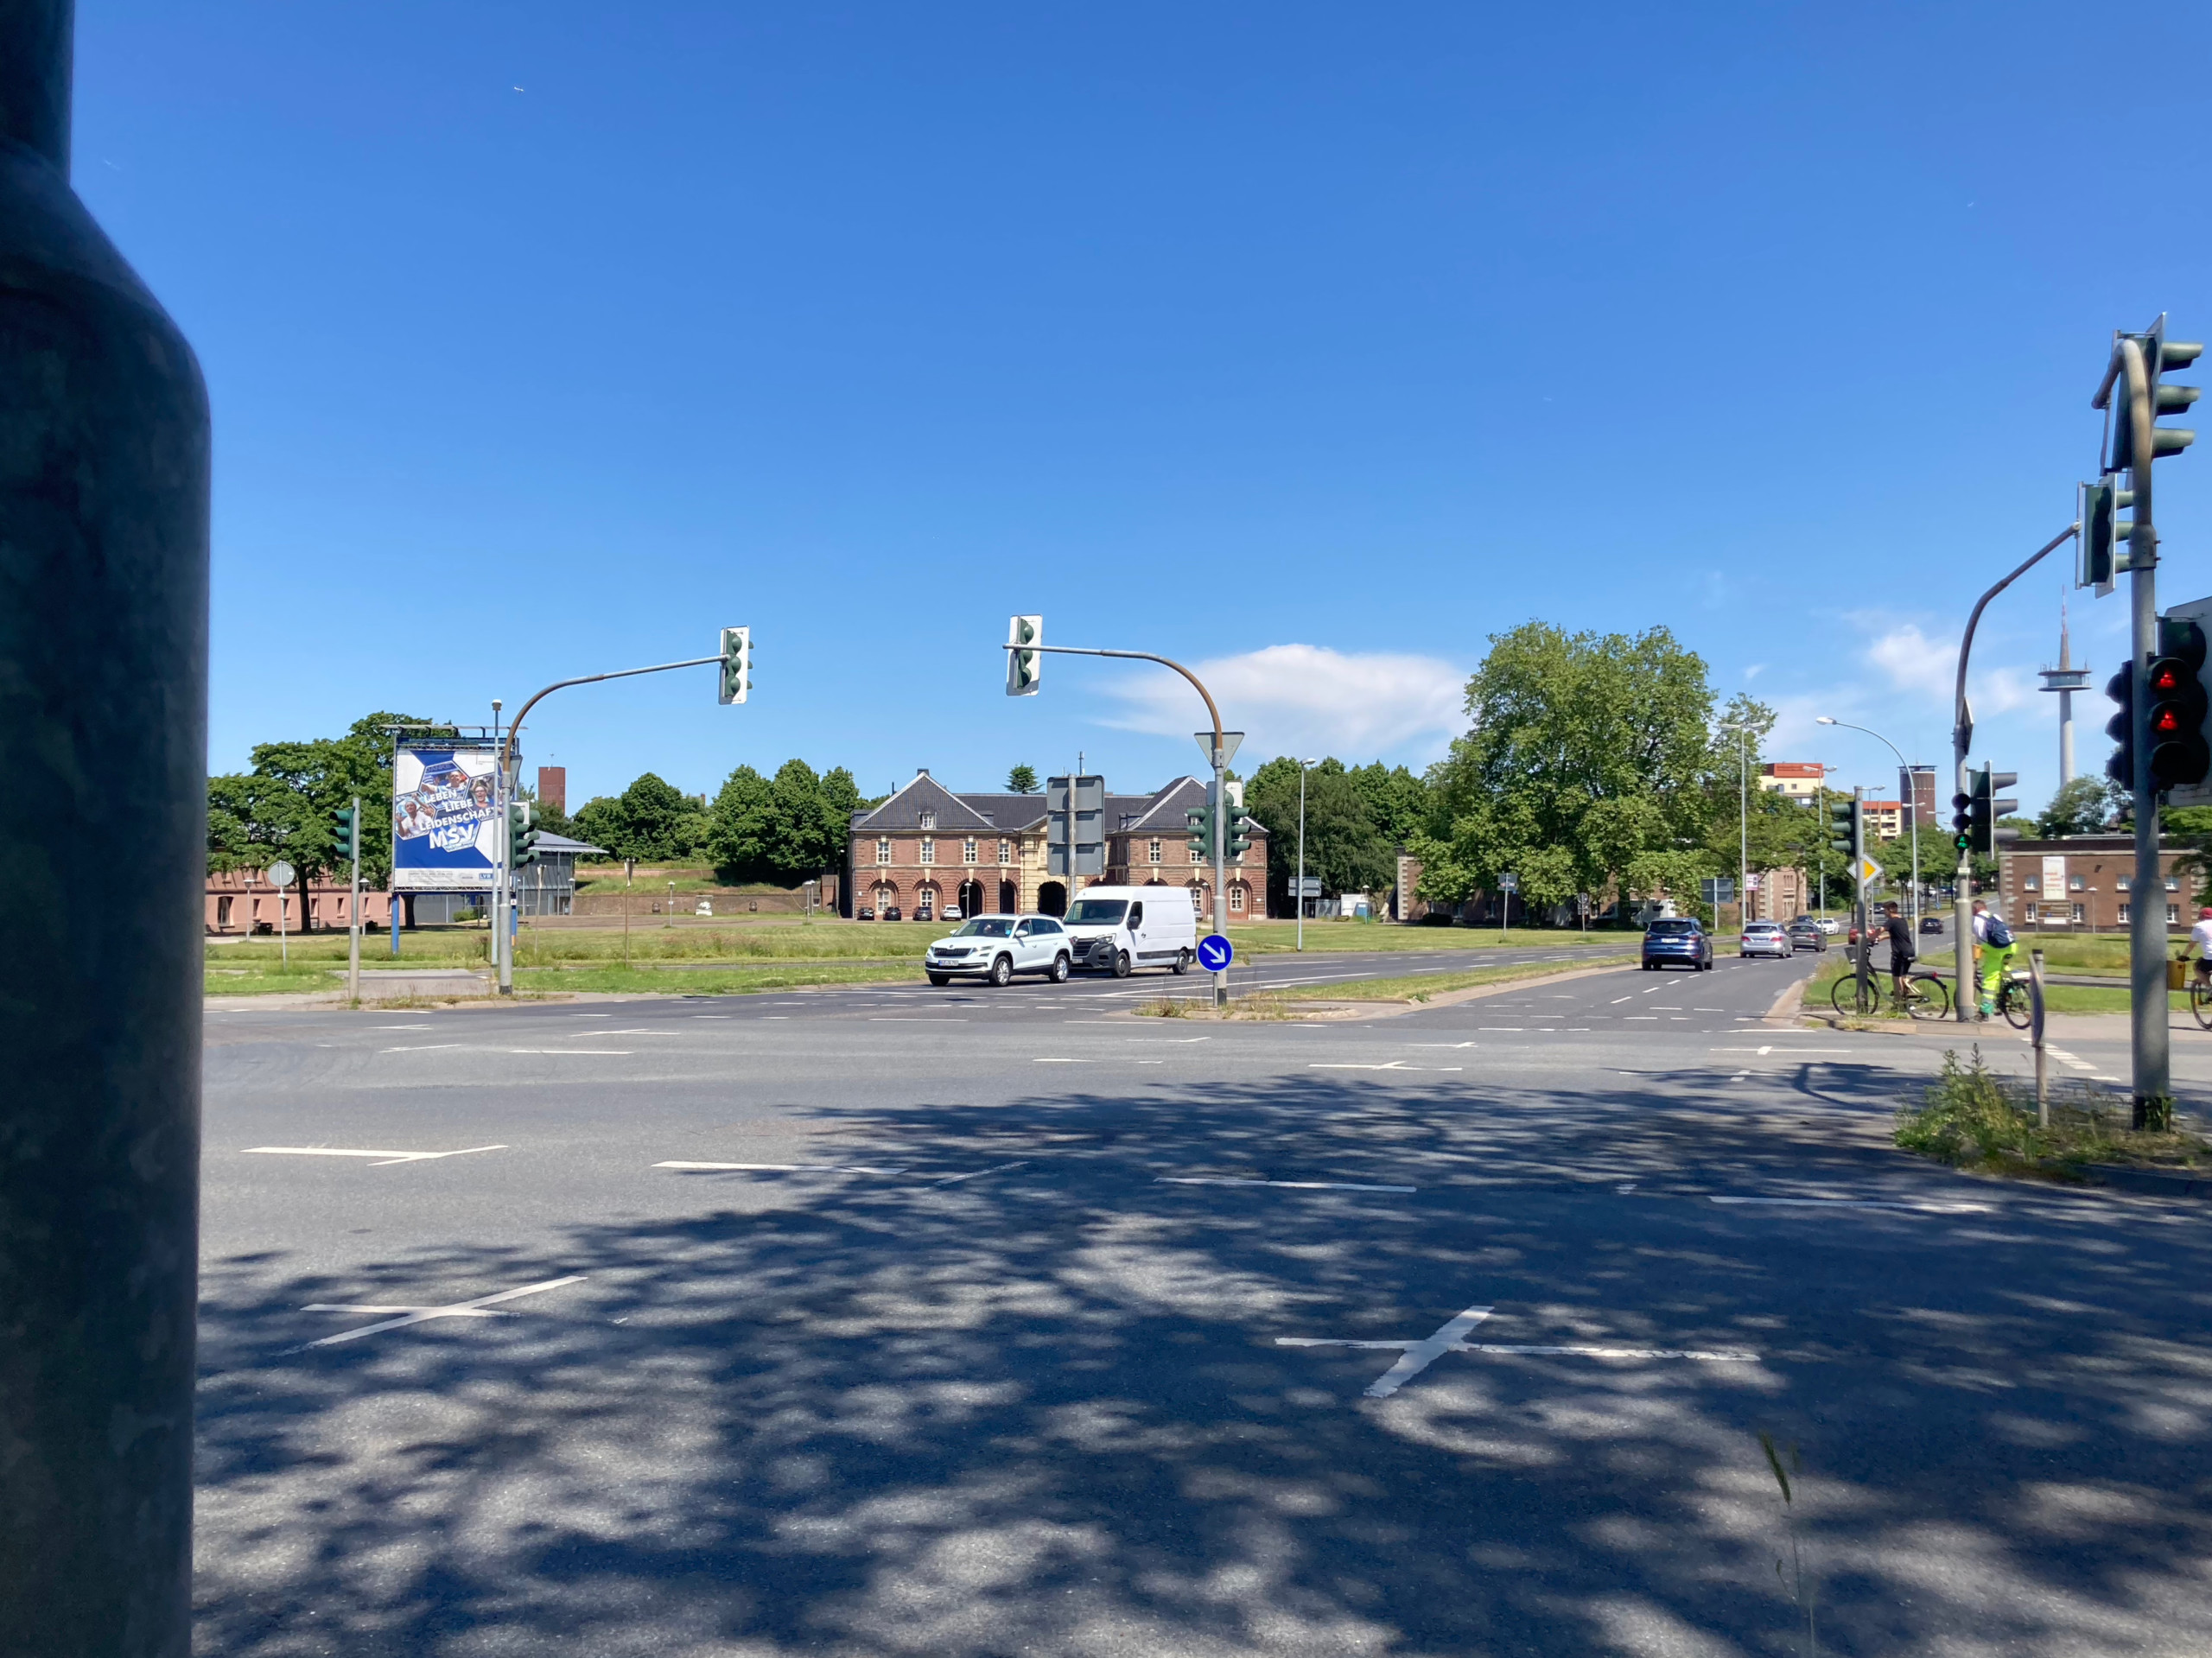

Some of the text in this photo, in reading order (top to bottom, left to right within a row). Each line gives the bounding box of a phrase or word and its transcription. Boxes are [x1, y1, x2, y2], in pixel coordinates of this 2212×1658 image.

[424, 790, 457, 804] LEBEN
[445, 798, 474, 812] LIEBE
[429, 823, 474, 849] MSV
